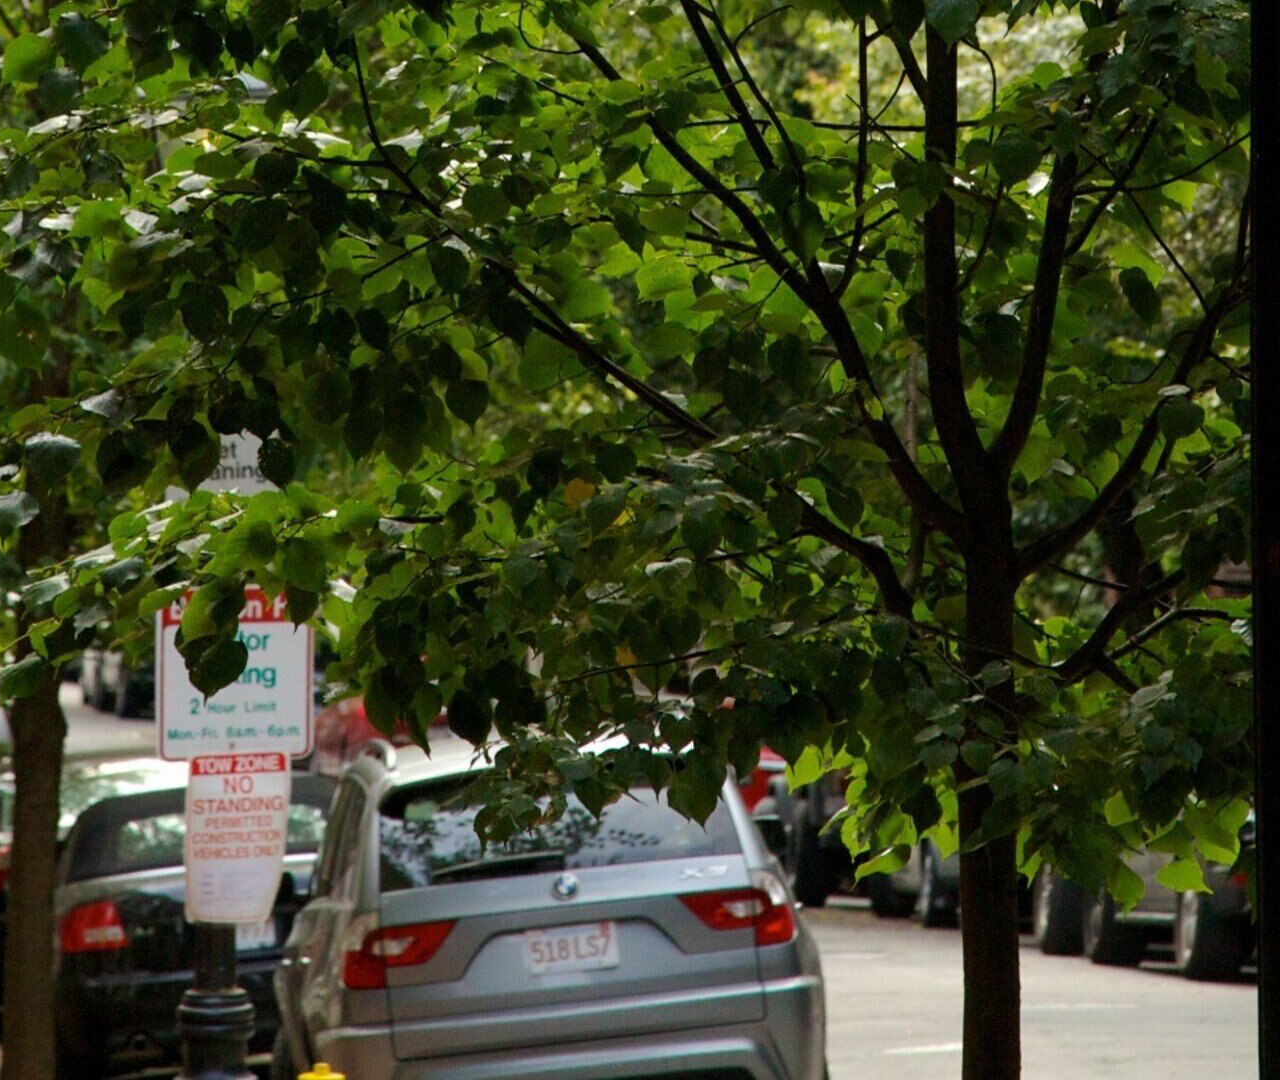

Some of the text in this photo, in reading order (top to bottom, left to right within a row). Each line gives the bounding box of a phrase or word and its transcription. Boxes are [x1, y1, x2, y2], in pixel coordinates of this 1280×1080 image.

[189, 698, 200, 715] 2
[197, 754, 280, 773] TOW ZONE
[223, 775, 253, 794] NO
[193, 795, 284, 814] STANDING
[204, 815, 273, 829] PERMITTED
[192, 830, 282, 845] CONSTRUCTION
[193, 846, 249, 860] VEHICLES
[530, 934, 610, 964] 518 LS7
